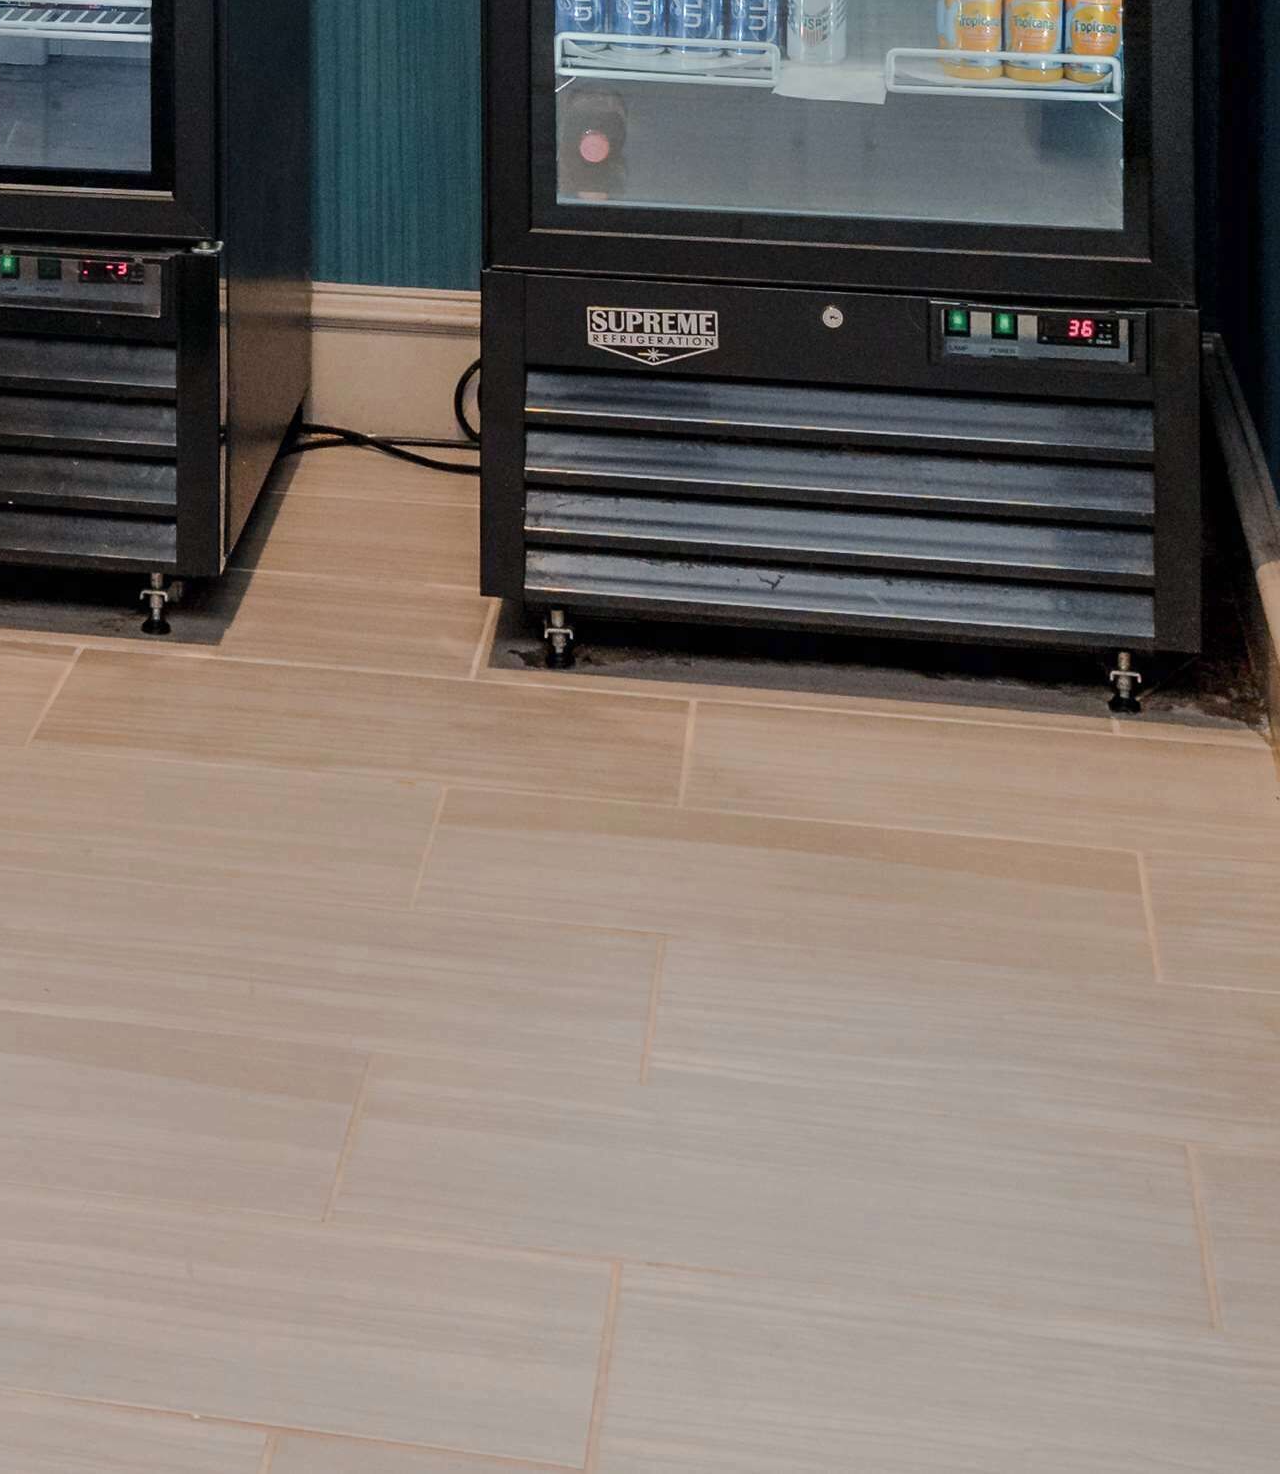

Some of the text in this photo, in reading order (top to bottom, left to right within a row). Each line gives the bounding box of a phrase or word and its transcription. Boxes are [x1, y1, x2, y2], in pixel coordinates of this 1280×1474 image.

[1074, 19, 1117, 34] Tropicana
[591, 310, 715, 335] SUPREME
[1068, 319, 1094, 338] 36
[592, 333, 715, 346] REFRIGERATION
